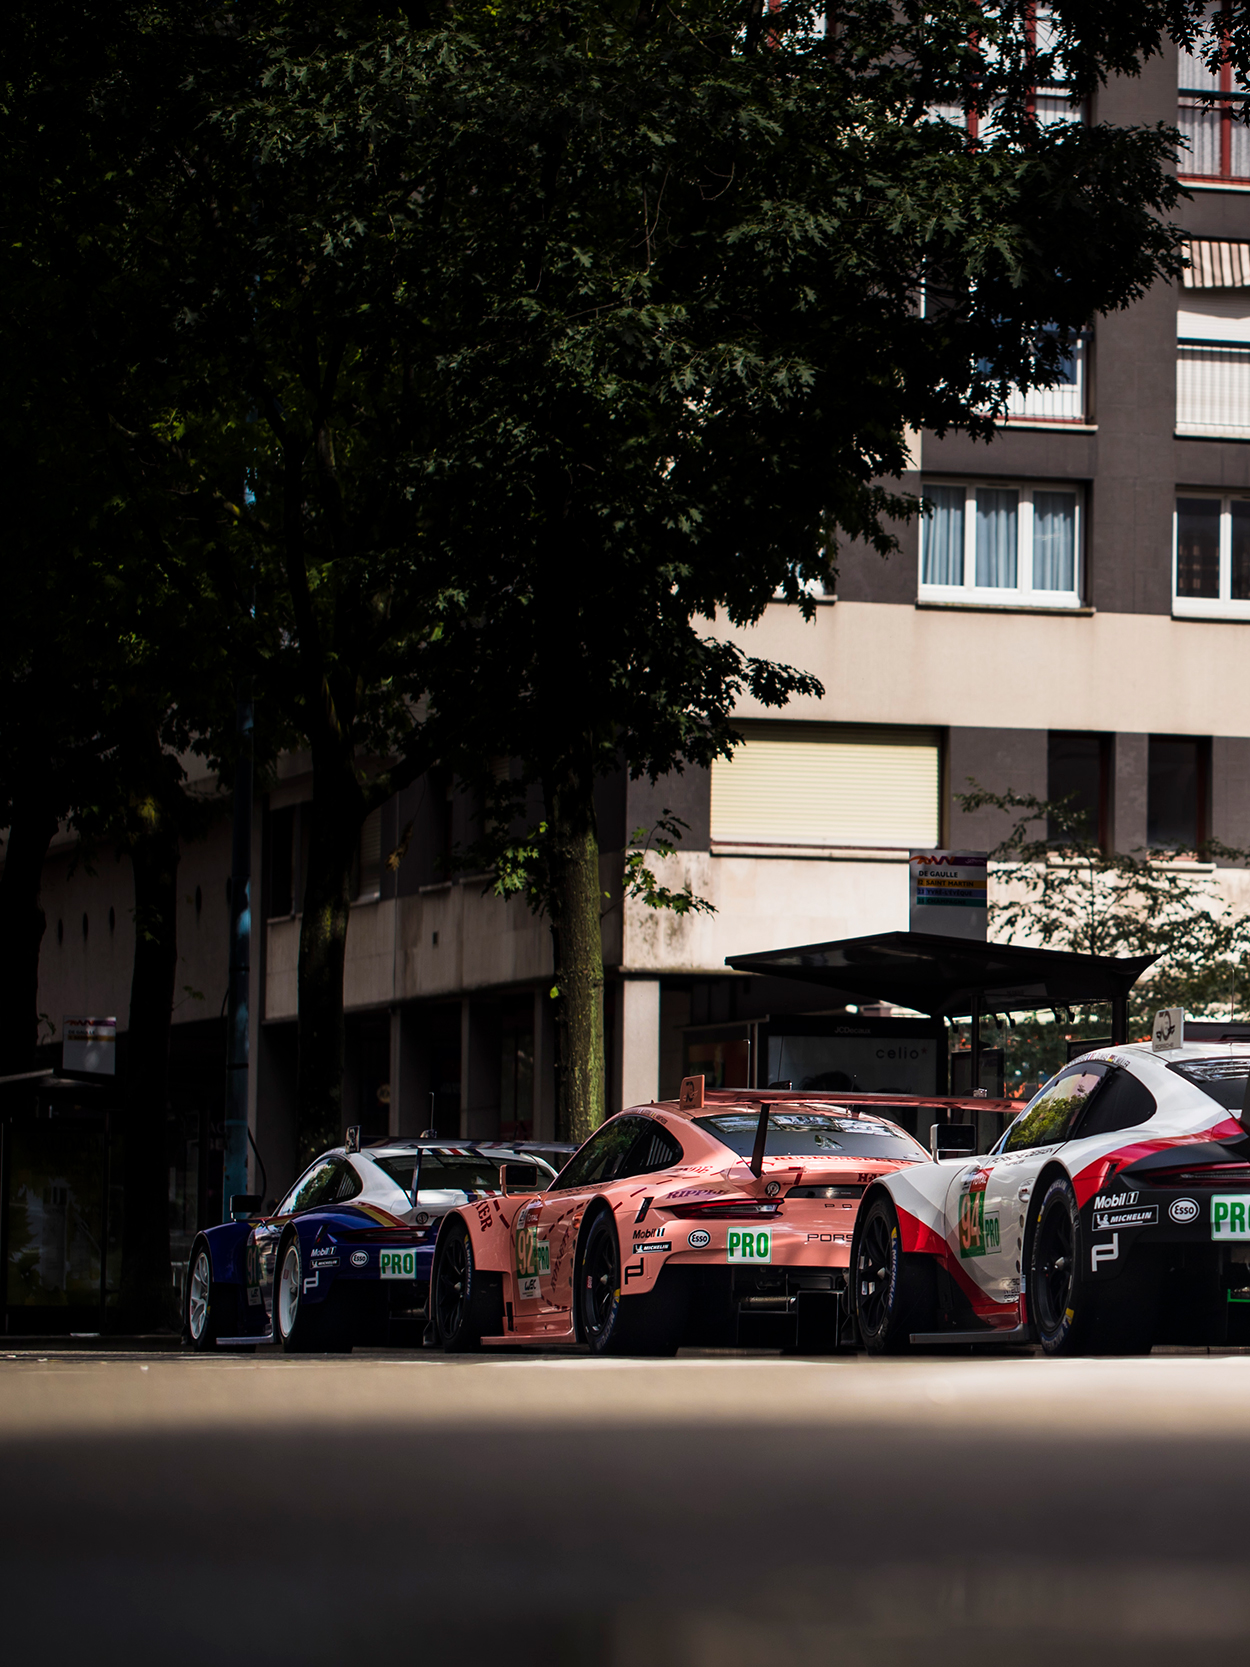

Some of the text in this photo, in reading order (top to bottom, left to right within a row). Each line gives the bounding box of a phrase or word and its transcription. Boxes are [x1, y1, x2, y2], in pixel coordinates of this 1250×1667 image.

[930, 870, 958, 878] GAULLE
[834, 1026, 871, 1034] JCDecaux
[1094, 1192, 1126, 1210] Mobil
[1175, 1204, 1194, 1215] Esso
[961, 1191, 981, 1249] 94
[1110, 1211, 1152, 1224] MICHELIN
[632, 1229, 655, 1239] Mobil
[692, 1234, 707, 1242] Esso
[807, 1233, 853, 1242] PORS
[985, 1217, 1000, 1248] PRO
[729, 1232, 769, 1257] PRO
[353, 1254, 367, 1262] Esso
[518, 1230, 536, 1276] 92
[382, 1253, 413, 1275] PRO
